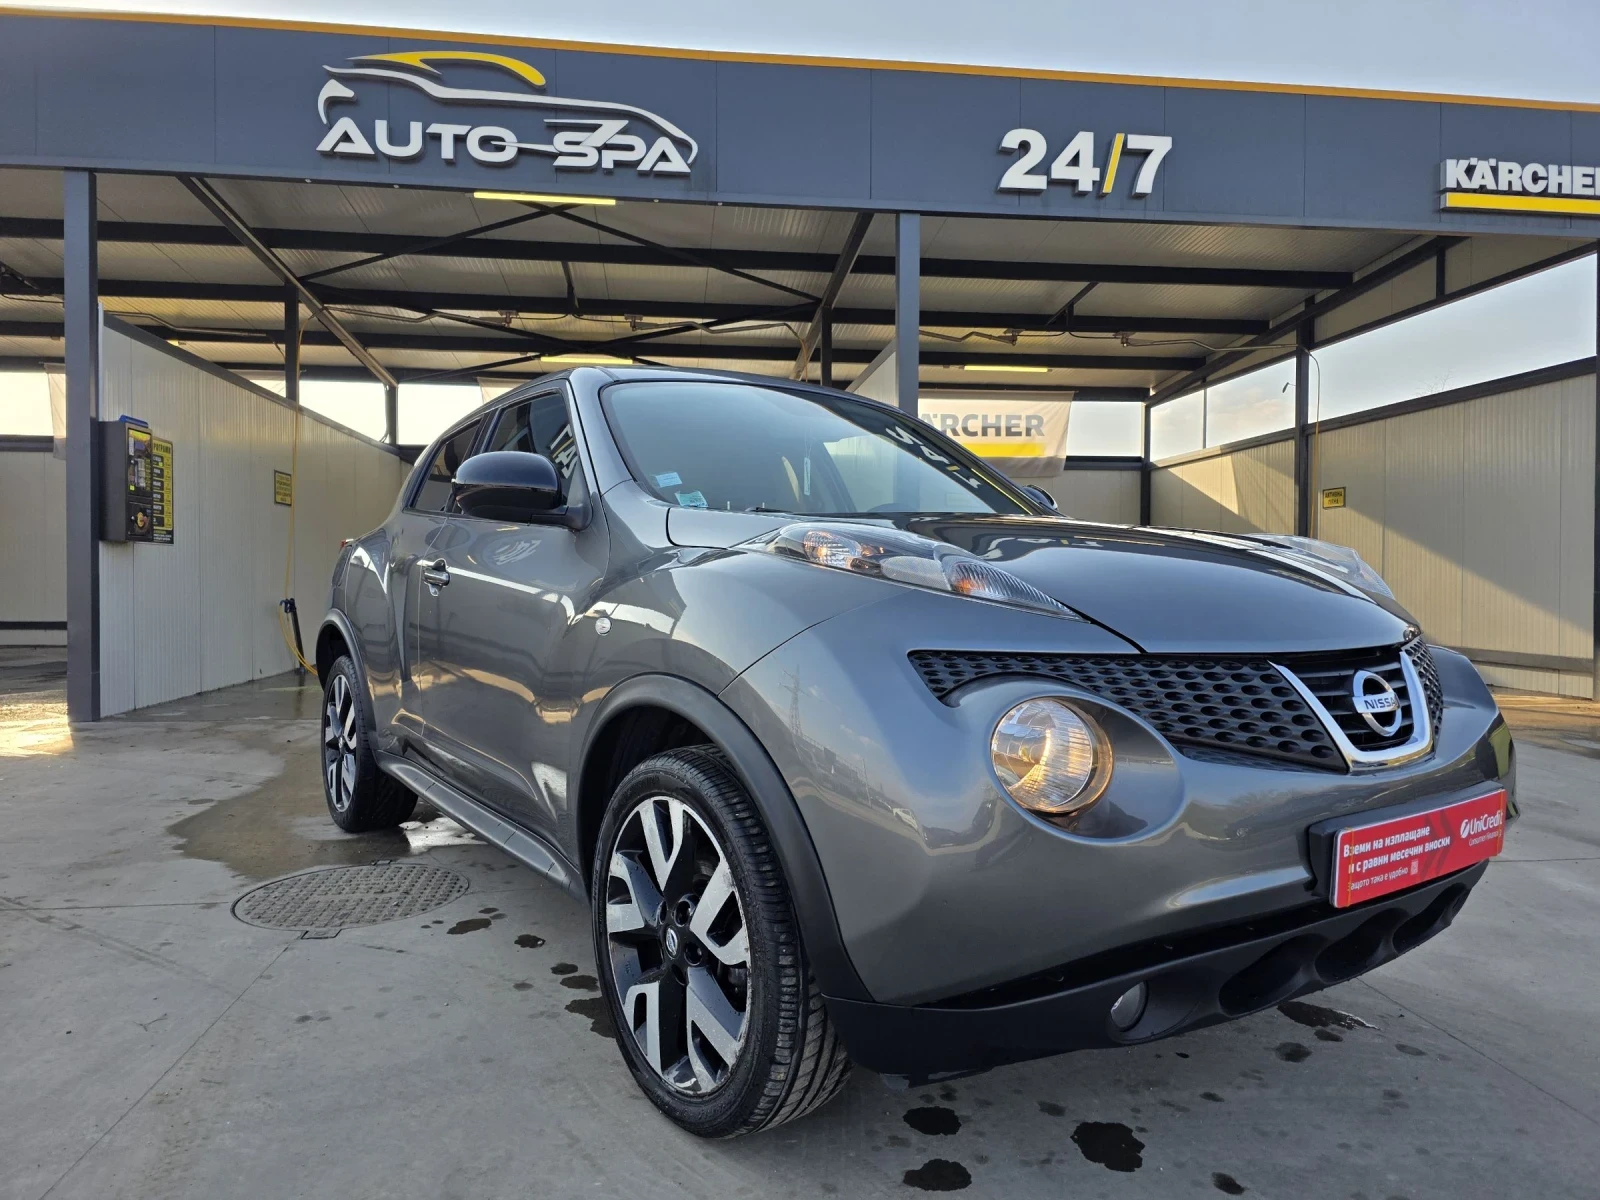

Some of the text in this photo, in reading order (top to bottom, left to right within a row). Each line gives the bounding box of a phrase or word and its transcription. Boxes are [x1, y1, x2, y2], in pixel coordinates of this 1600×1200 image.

[315, 117, 692, 173] AUTO SPA
[999, 128, 1172, 195] 24/7
[1444, 157, 1600, 196] KÄRCHE
[1373, 839, 1383, 850] на
[1385, 826, 1430, 846] изплащане
[1470, 809, 1503, 835] UniCredit
[1363, 856, 1388, 873] равни
[1390, 846, 1423, 862] месечни
[1425, 836, 1451, 852] вноски
